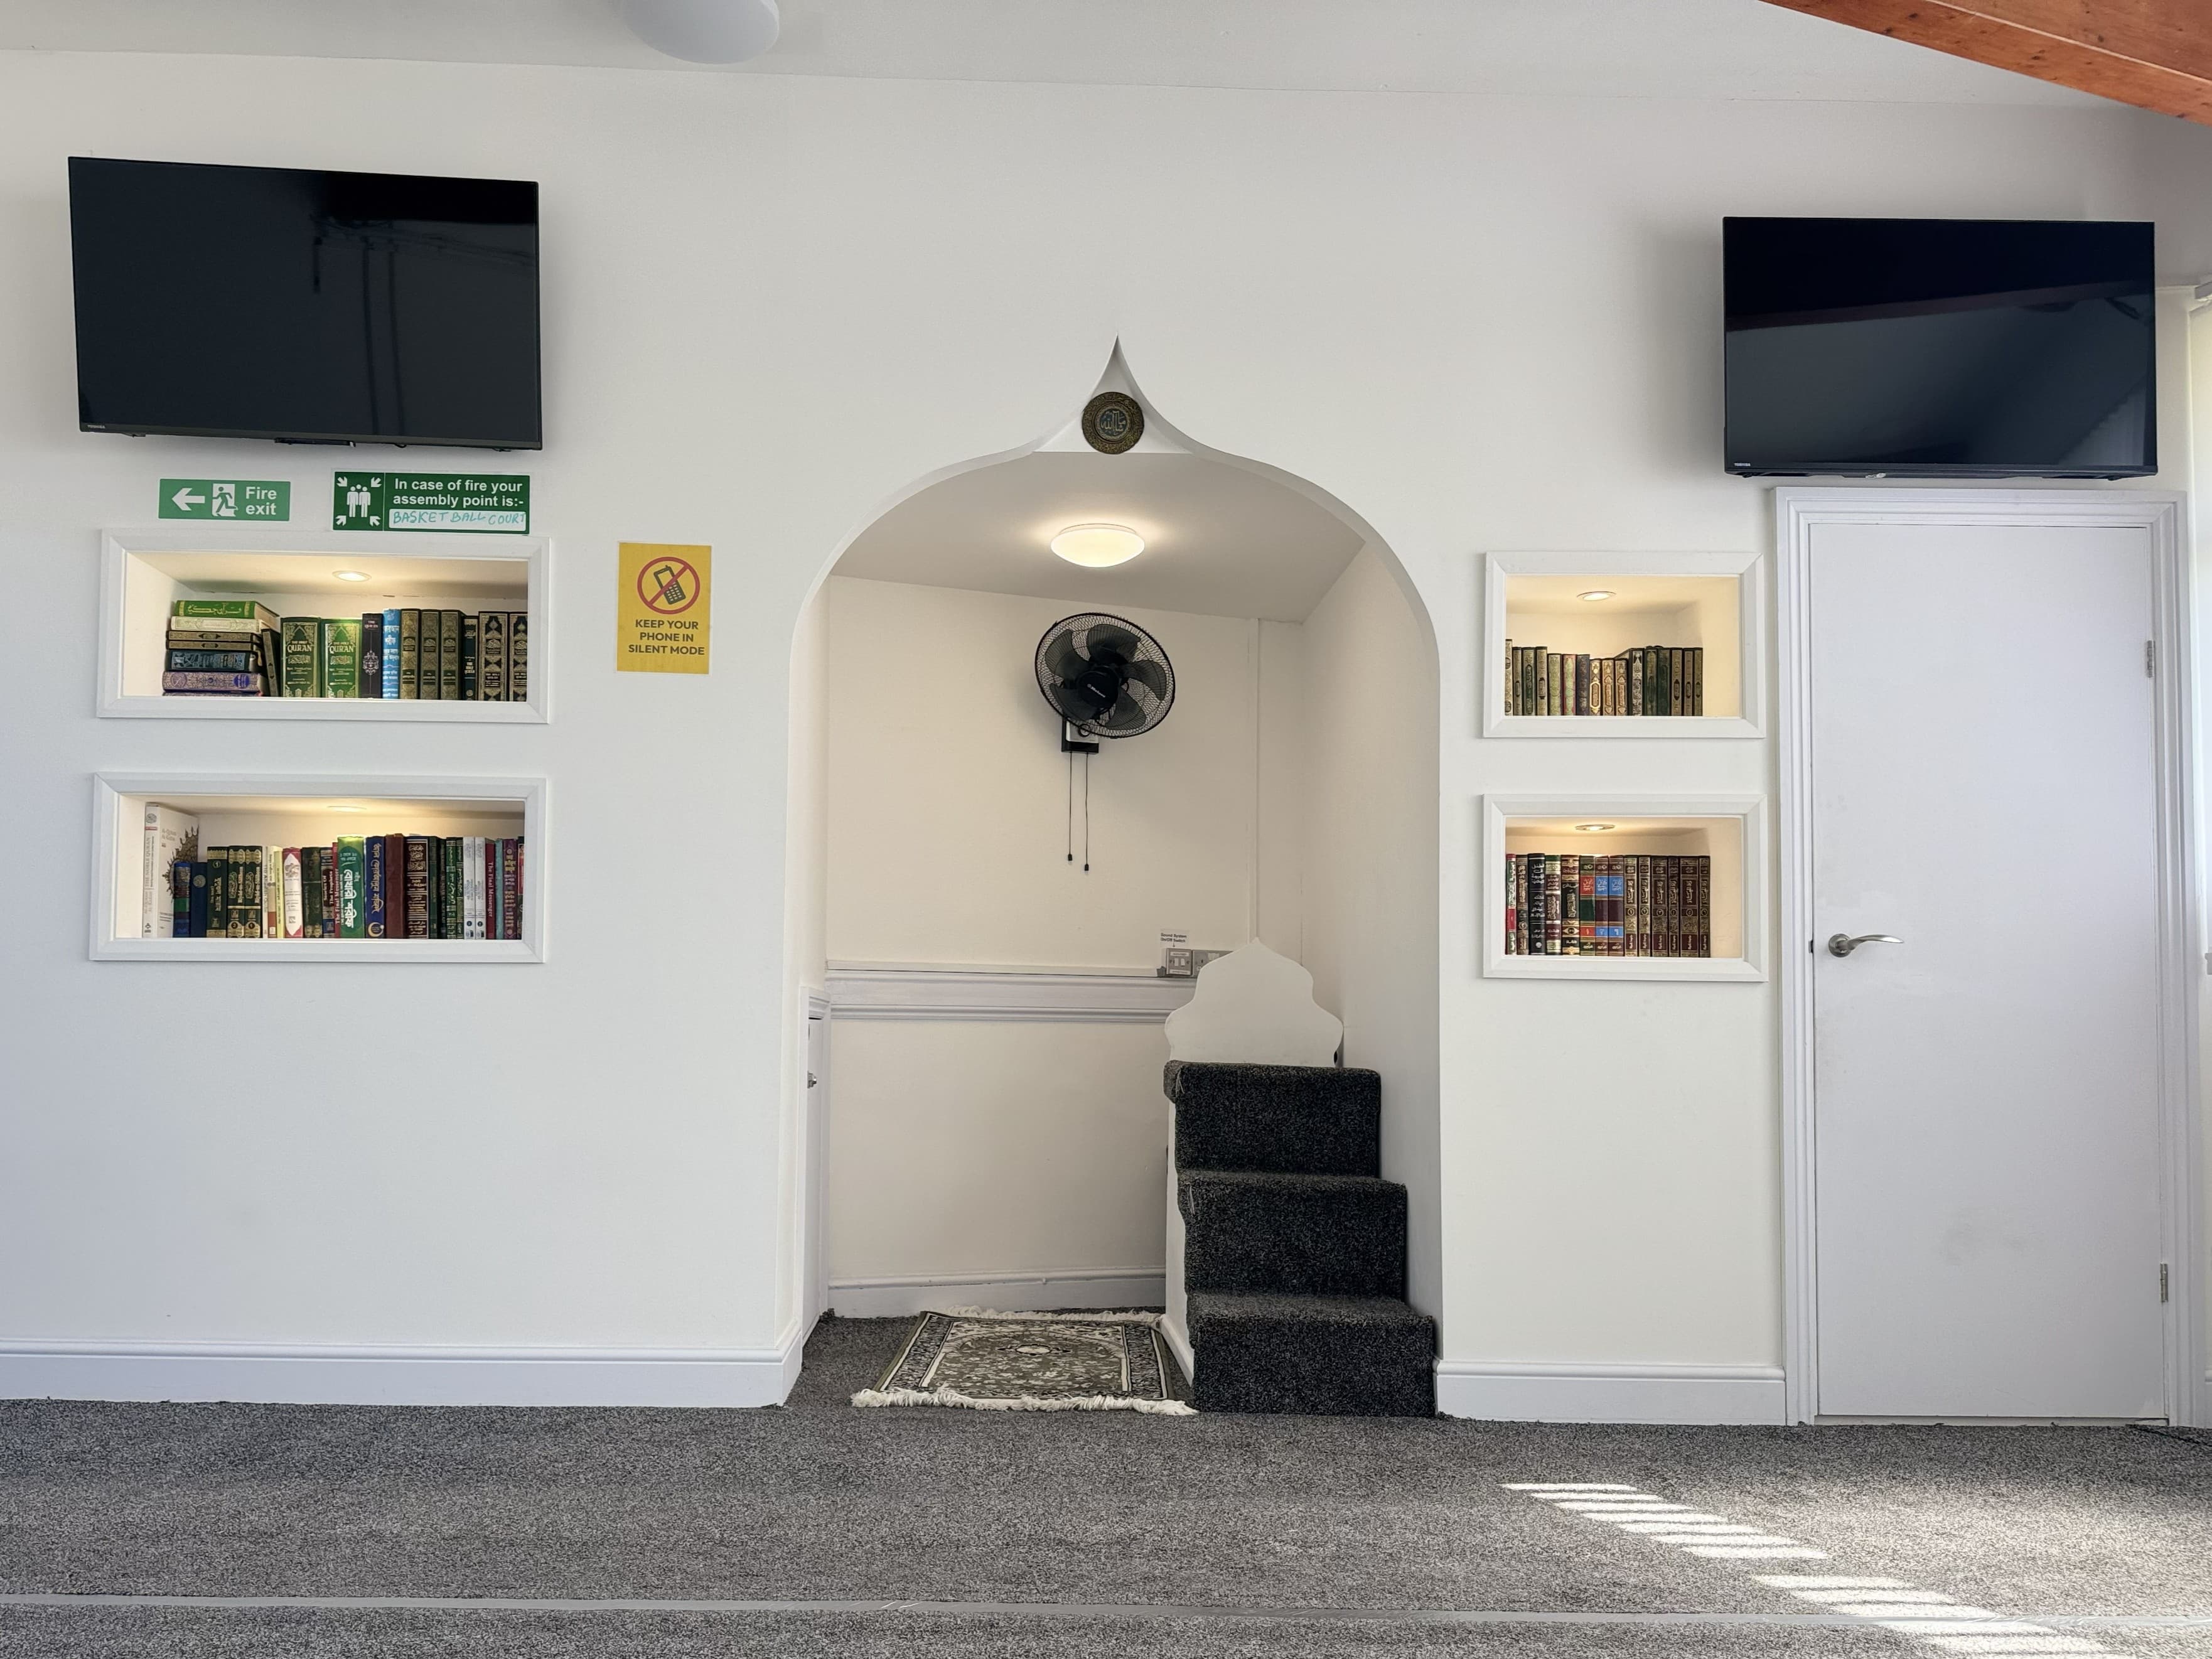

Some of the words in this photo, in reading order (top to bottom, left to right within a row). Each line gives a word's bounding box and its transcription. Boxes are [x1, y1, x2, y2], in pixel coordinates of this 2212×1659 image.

[245, 486, 277, 500] Fire
[394, 478, 407, 490] In
[411, 481, 443, 490] case
[447, 480, 461, 491] of
[464, 480, 487, 491] fire
[491, 482, 523, 494] your
[393, 494, 458, 508] assembly
[463, 495, 498, 508] point
[502, 495, 524, 507] is:-
[245, 503, 277, 517] exit
[393, 511, 448, 524] BASKET
[450, 512, 486, 522] BALL
[488, 513, 525, 525] COURT
[635, 619, 665, 628] KEEP
[667, 620, 699, 630] YOUR
[640, 632, 680, 642] PHONE
[682, 634, 694, 642] IN
[628, 644, 668, 654] SILENT
[670, 646, 705, 655] MODE
[344, 869, 357, 899] বোখারী
[345, 899, 357, 928] শরীফ
